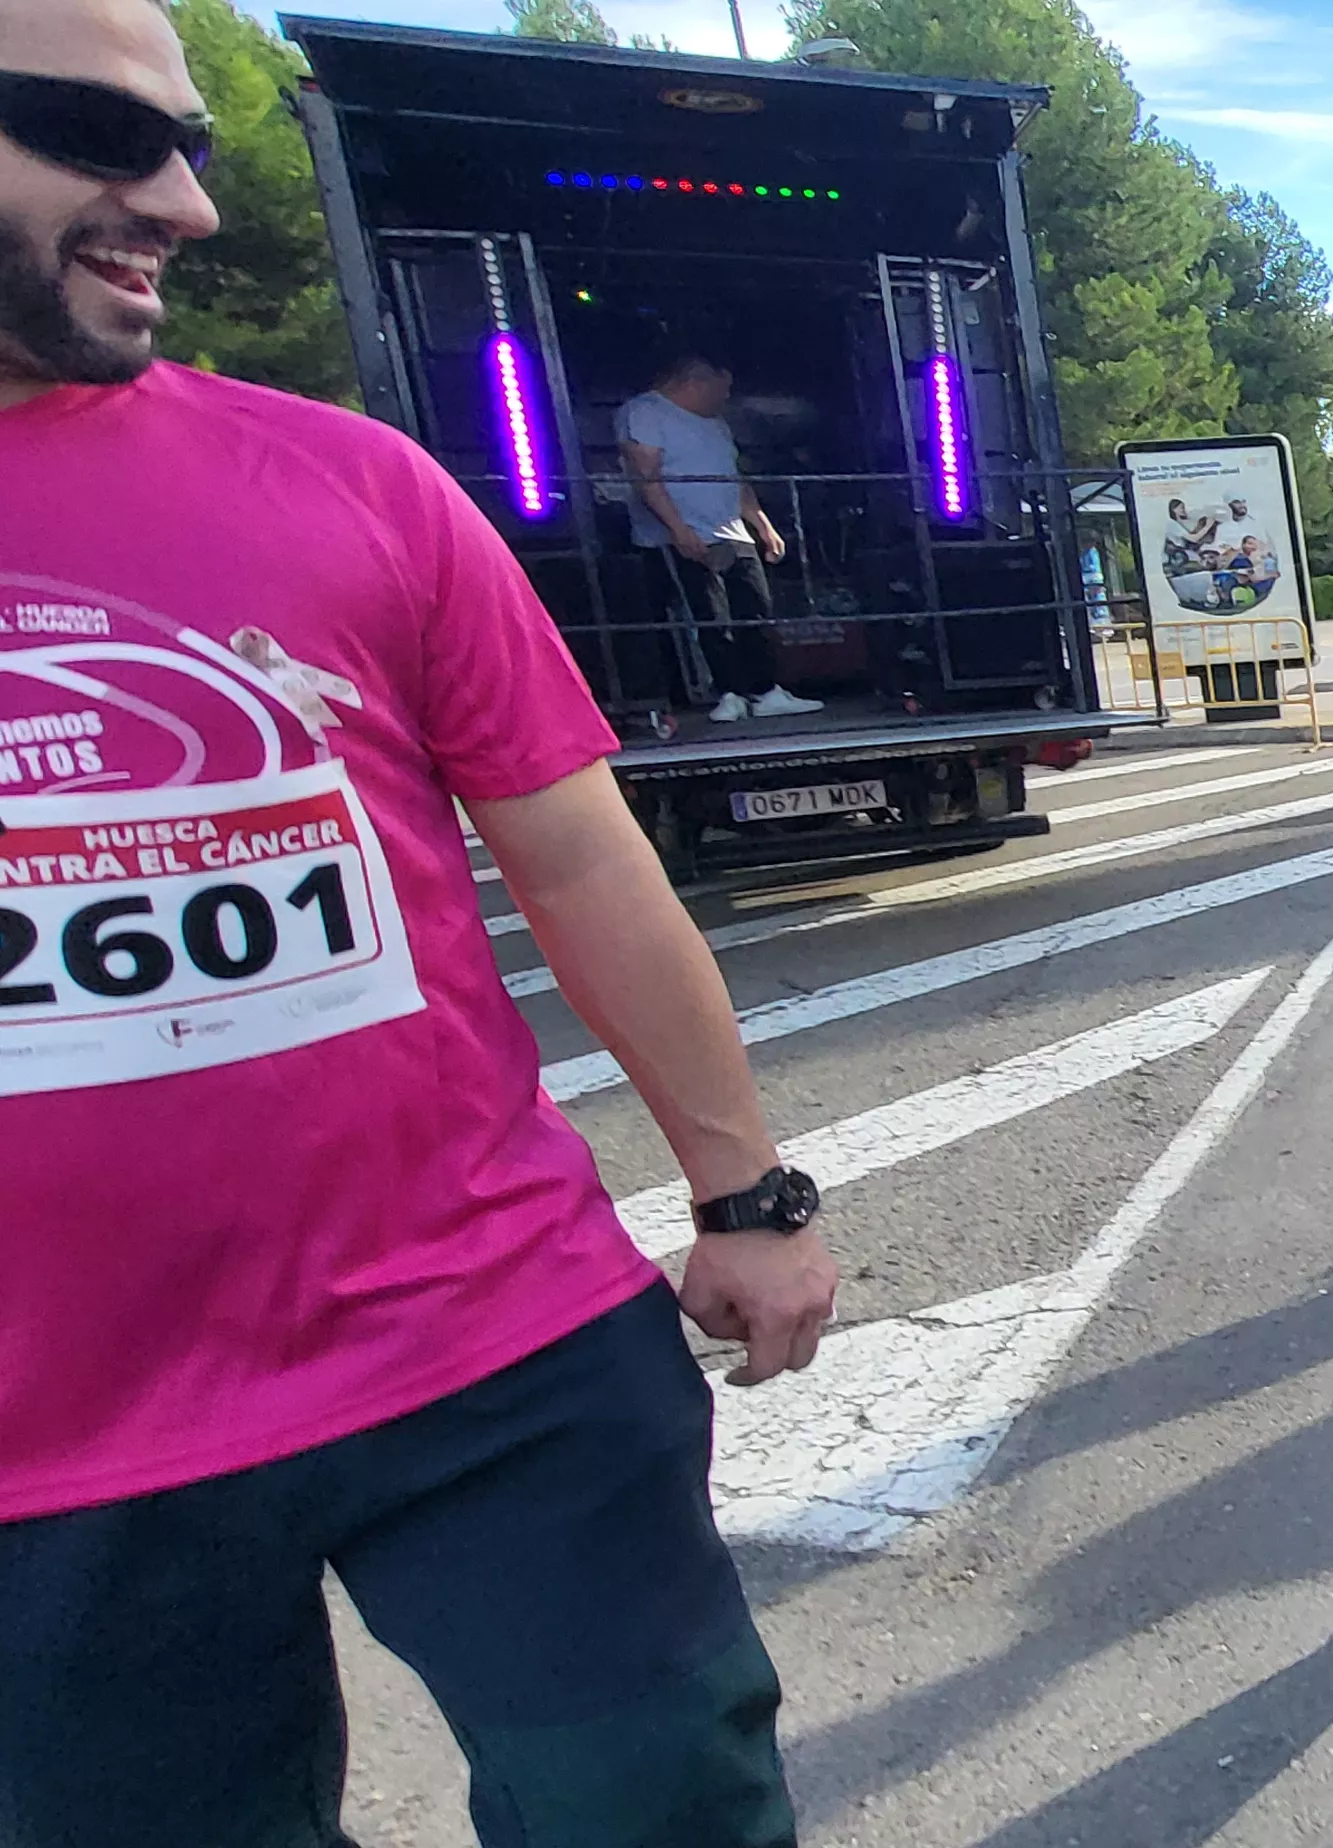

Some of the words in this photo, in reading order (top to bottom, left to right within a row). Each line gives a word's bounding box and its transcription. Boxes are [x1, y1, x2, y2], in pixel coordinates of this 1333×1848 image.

[0, 740, 104, 785] NTOS
[752, 791, 818, 816] 0671
[0, 852, 130, 886] NTRA
[137, 847, 191, 874] EL
[200, 818, 343, 868] CÁNCER
[83, 820, 218, 851] HUESCA
[0, 863, 356, 1006] 2601
